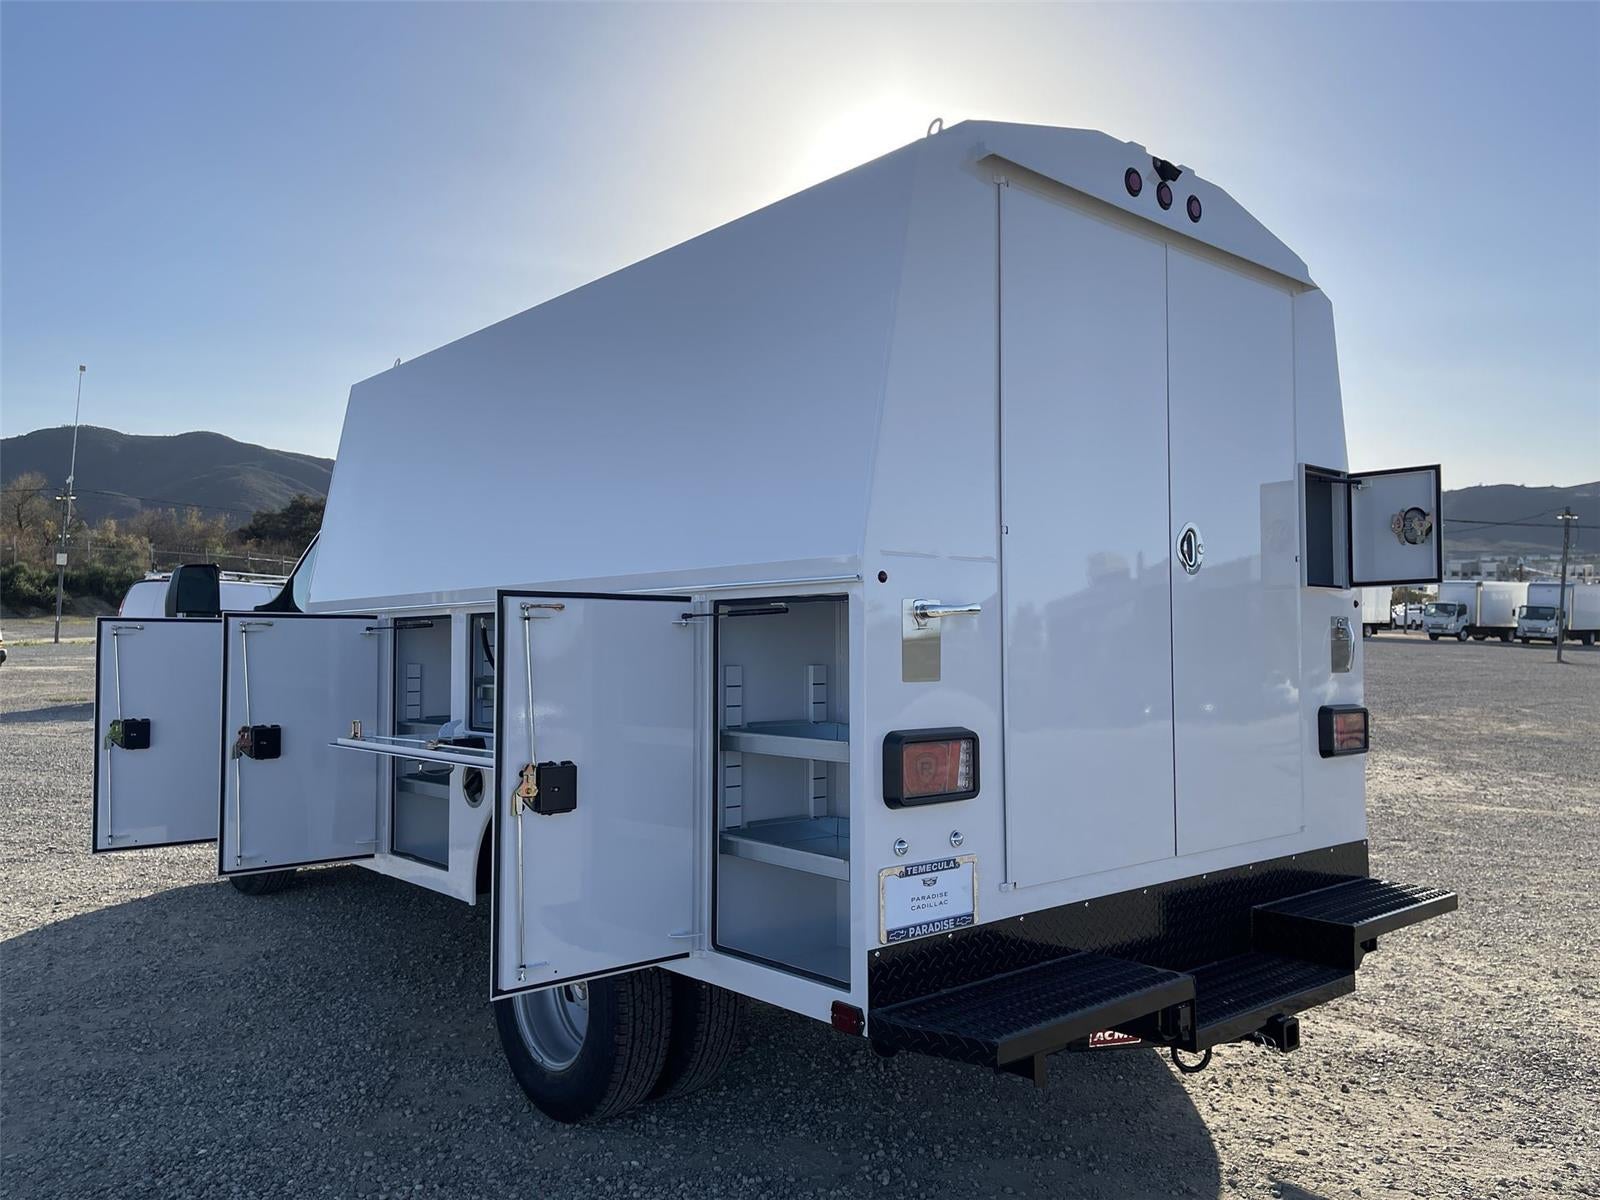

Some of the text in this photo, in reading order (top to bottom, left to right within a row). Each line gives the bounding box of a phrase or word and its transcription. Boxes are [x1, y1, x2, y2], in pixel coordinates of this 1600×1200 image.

[906, 860, 955, 875] TEMECULA
[910, 891, 949, 902] PARADISE
[910, 899, 949, 911] CADILLAC
[908, 918, 955, 937] PARADISE
[1093, 1030, 1133, 1041] ACM
